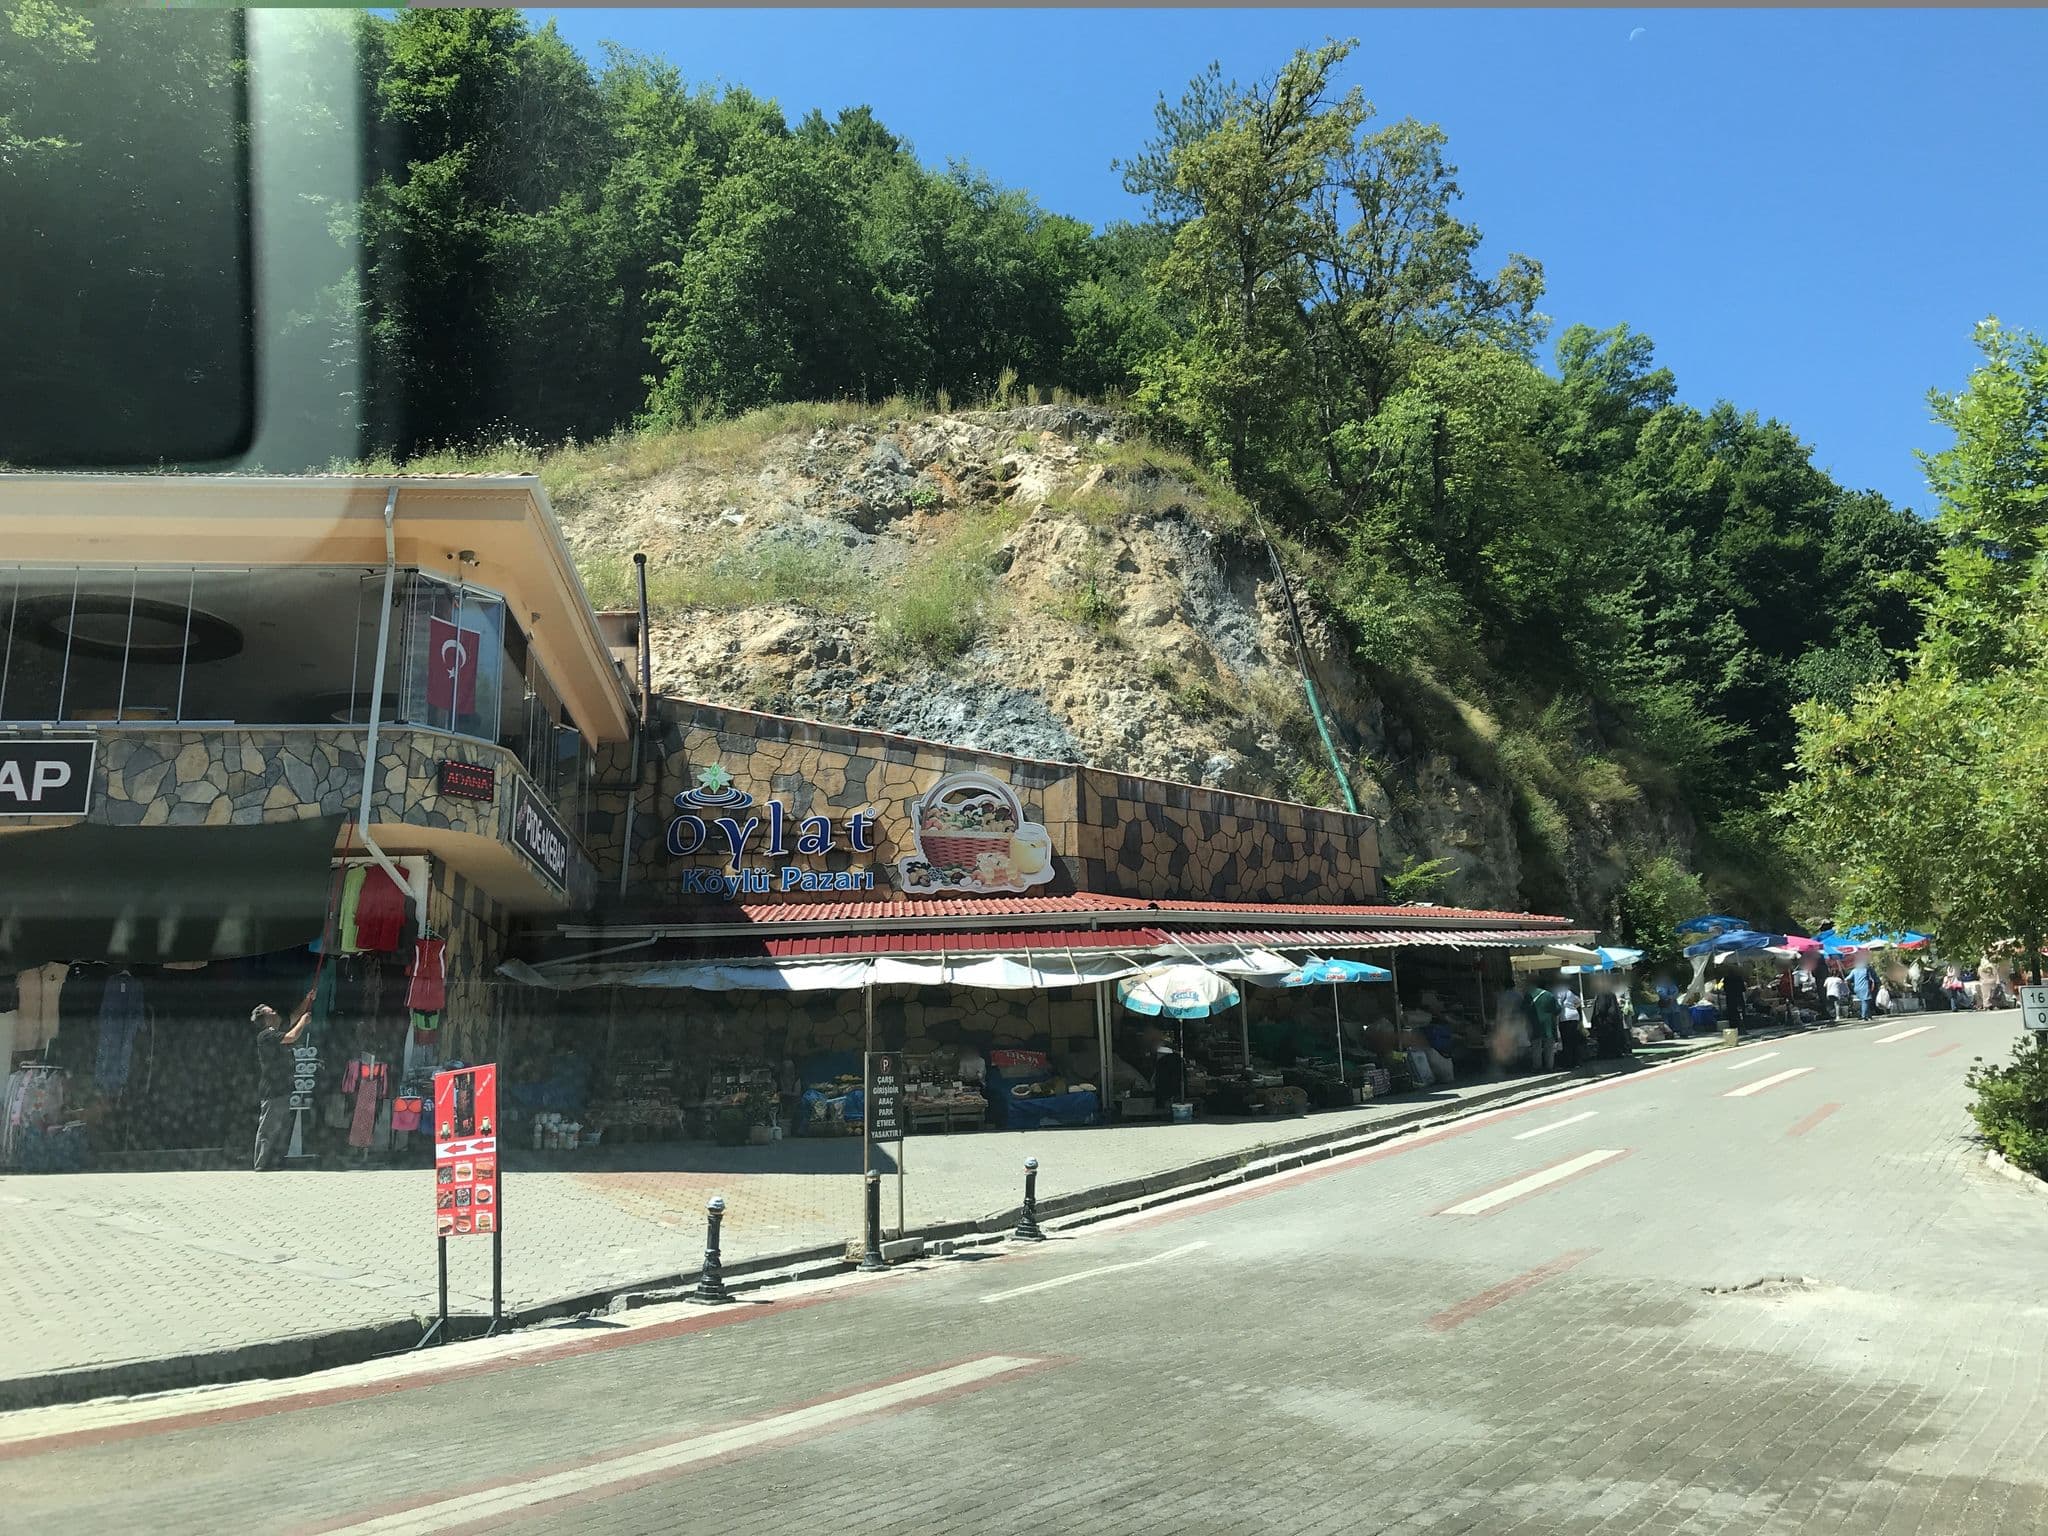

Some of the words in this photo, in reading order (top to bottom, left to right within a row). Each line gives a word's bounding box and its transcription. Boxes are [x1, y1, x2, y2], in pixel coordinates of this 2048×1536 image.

[0, 760, 71, 801] AP
[682, 867, 770, 900] Köylü
[780, 866, 875, 893] Pazarı
[2031, 992, 2045, 1003] 16
[878, 1097, 894, 1107] ARAÇ
[878, 1108, 894, 1116] PARK
[877, 1119, 896, 1127] ETMEK
